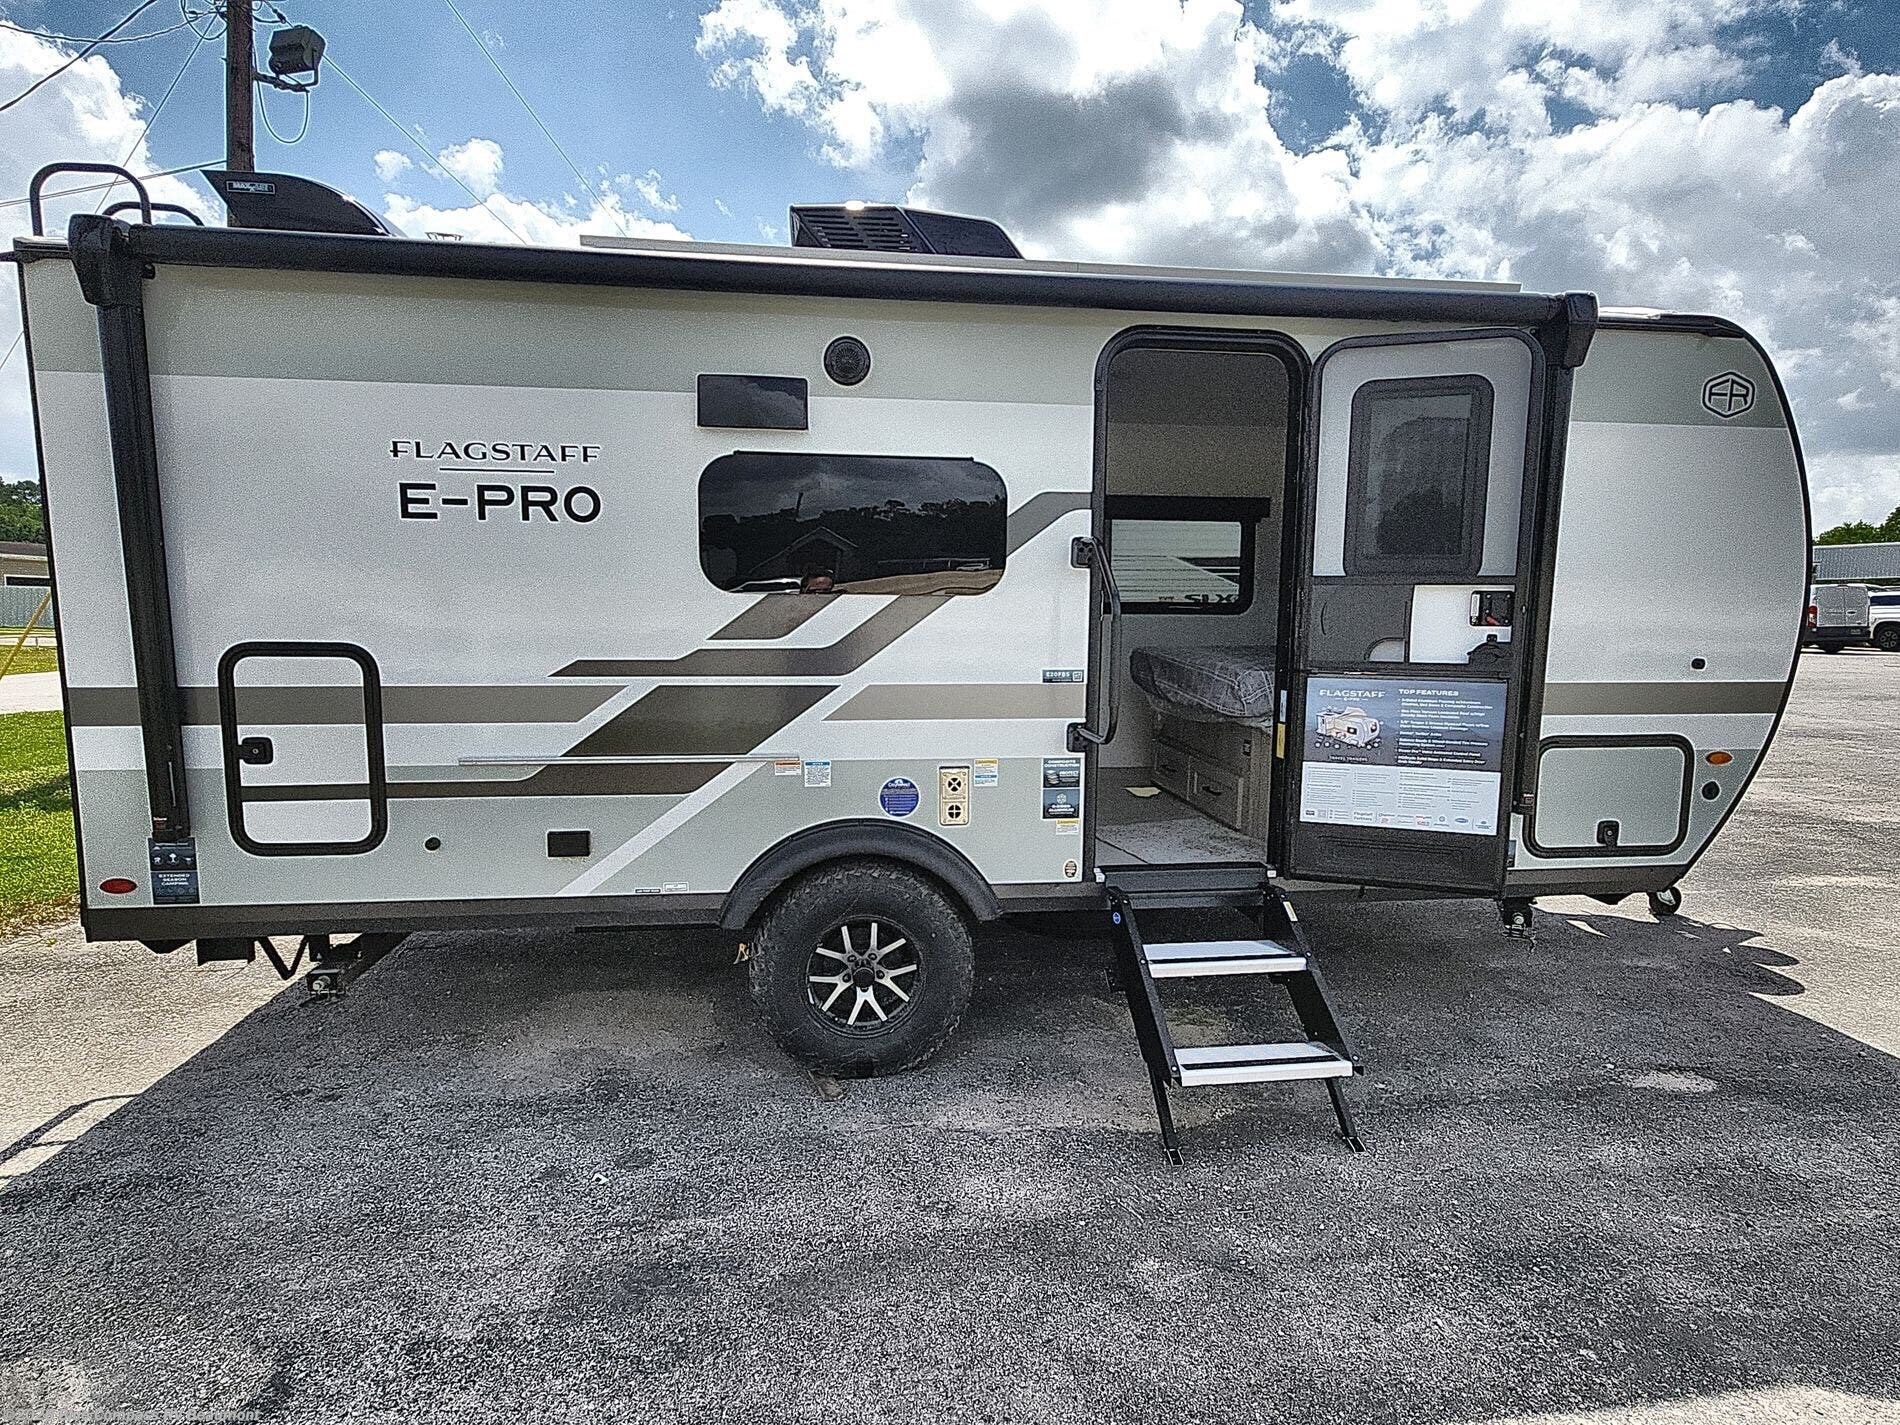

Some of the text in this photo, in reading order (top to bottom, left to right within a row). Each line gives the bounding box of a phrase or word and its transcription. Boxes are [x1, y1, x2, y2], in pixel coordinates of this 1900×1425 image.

[390, 440, 601, 463] FLAGSTAFF
[398, 482, 602, 523] E-PRO
[1319, 689, 1386, 698] FLAGSTAFF
